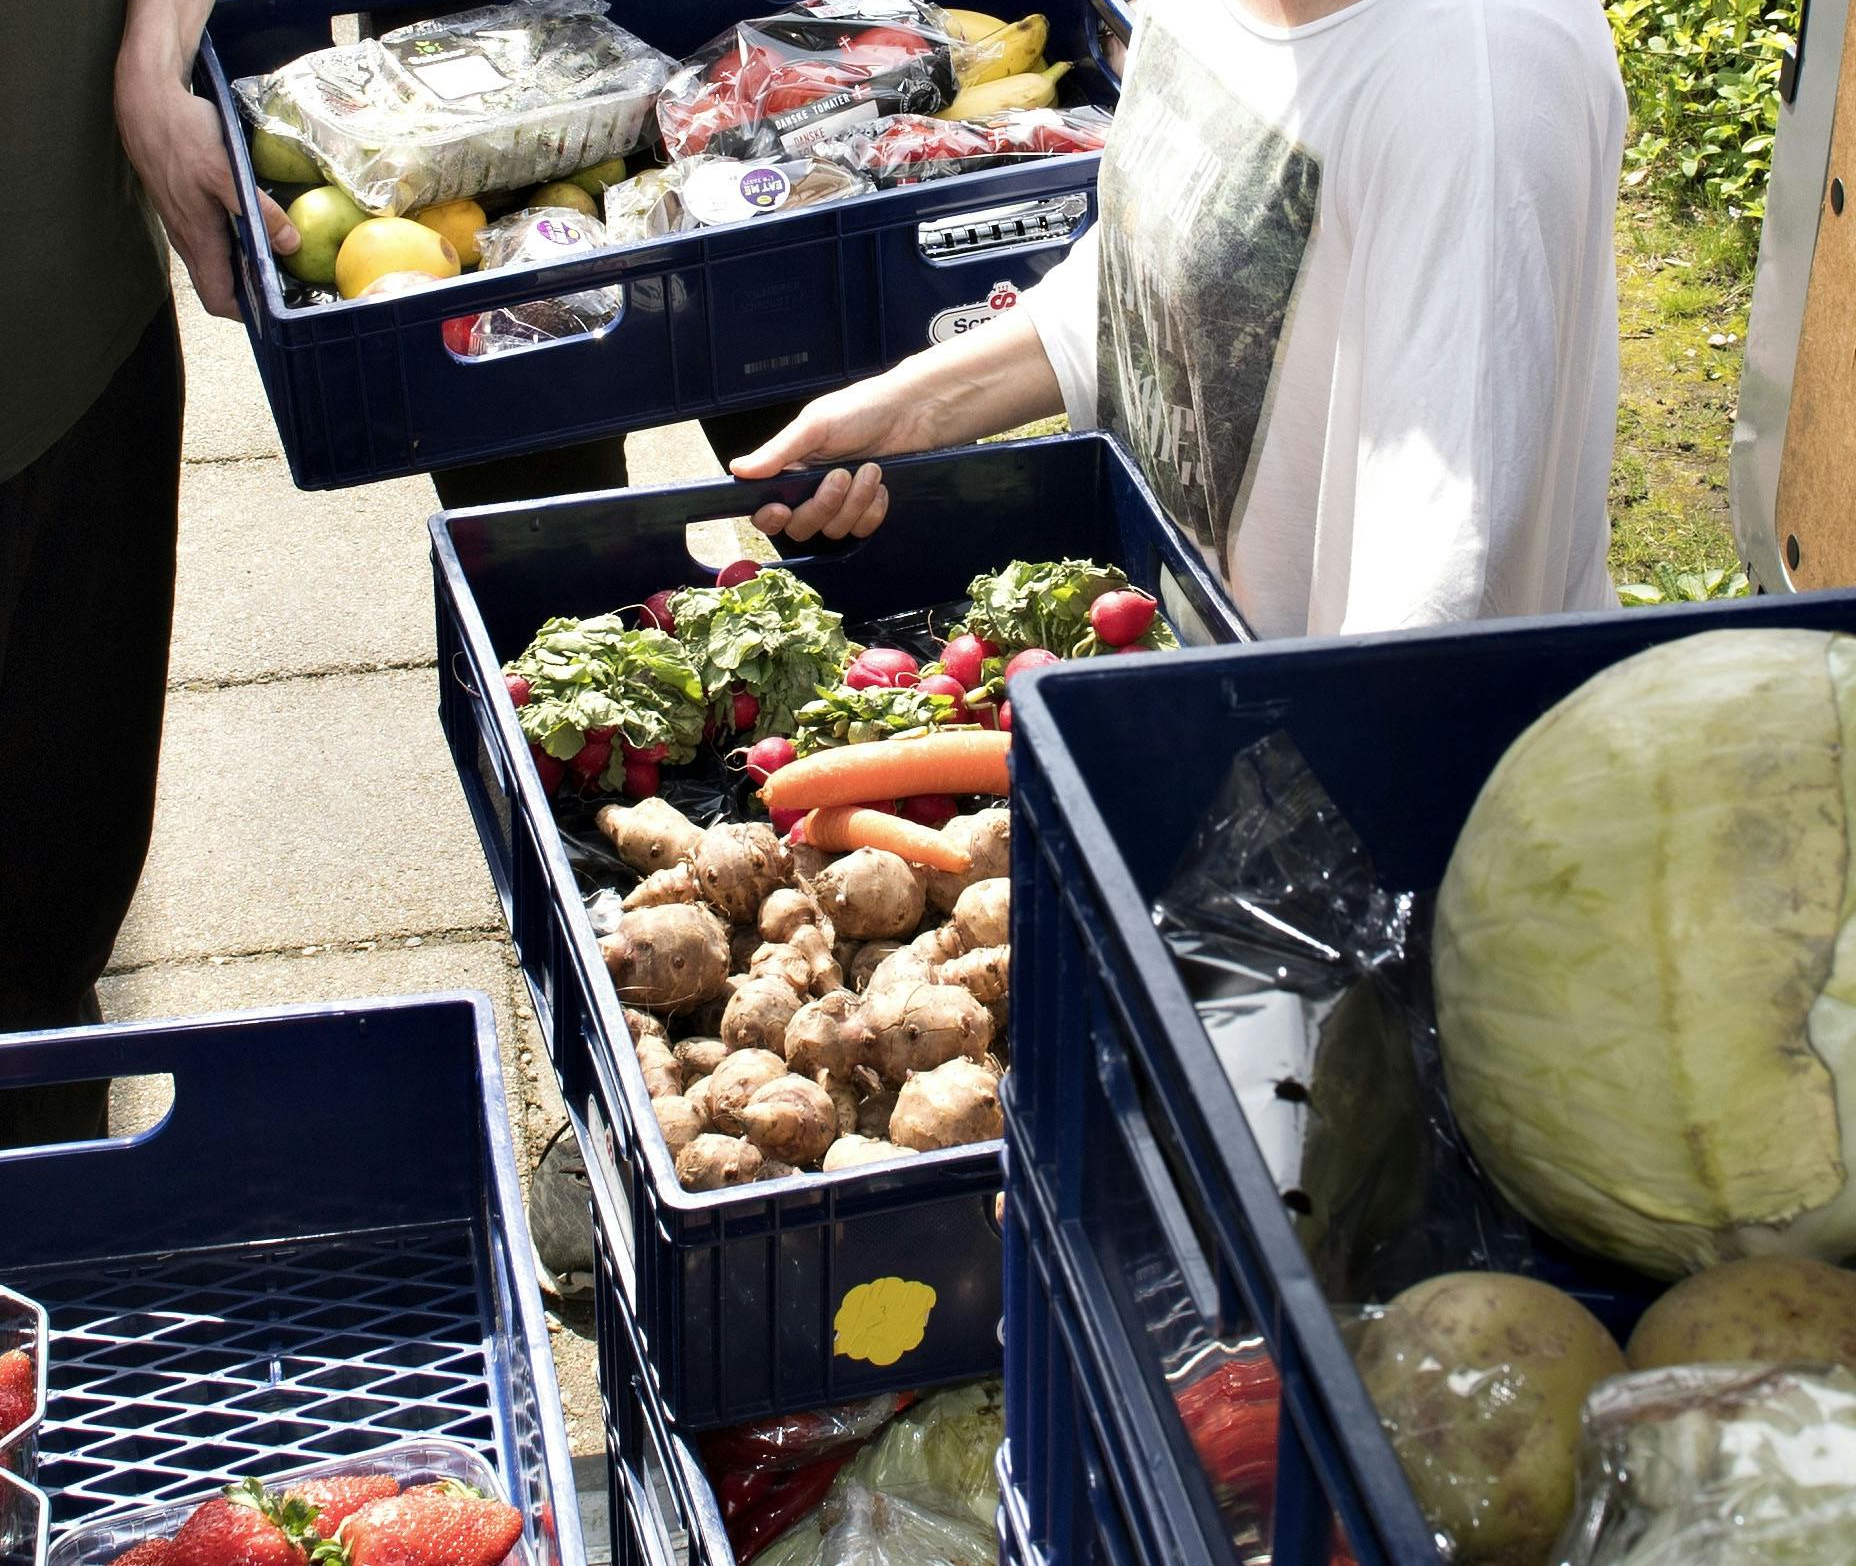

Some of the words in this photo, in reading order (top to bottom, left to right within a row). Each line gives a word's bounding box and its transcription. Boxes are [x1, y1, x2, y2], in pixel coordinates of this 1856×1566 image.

[775, 110, 809, 130] DANSKE
[811, 93, 851, 115] TOMATER
[793, 127, 825, 146] DANSKE
